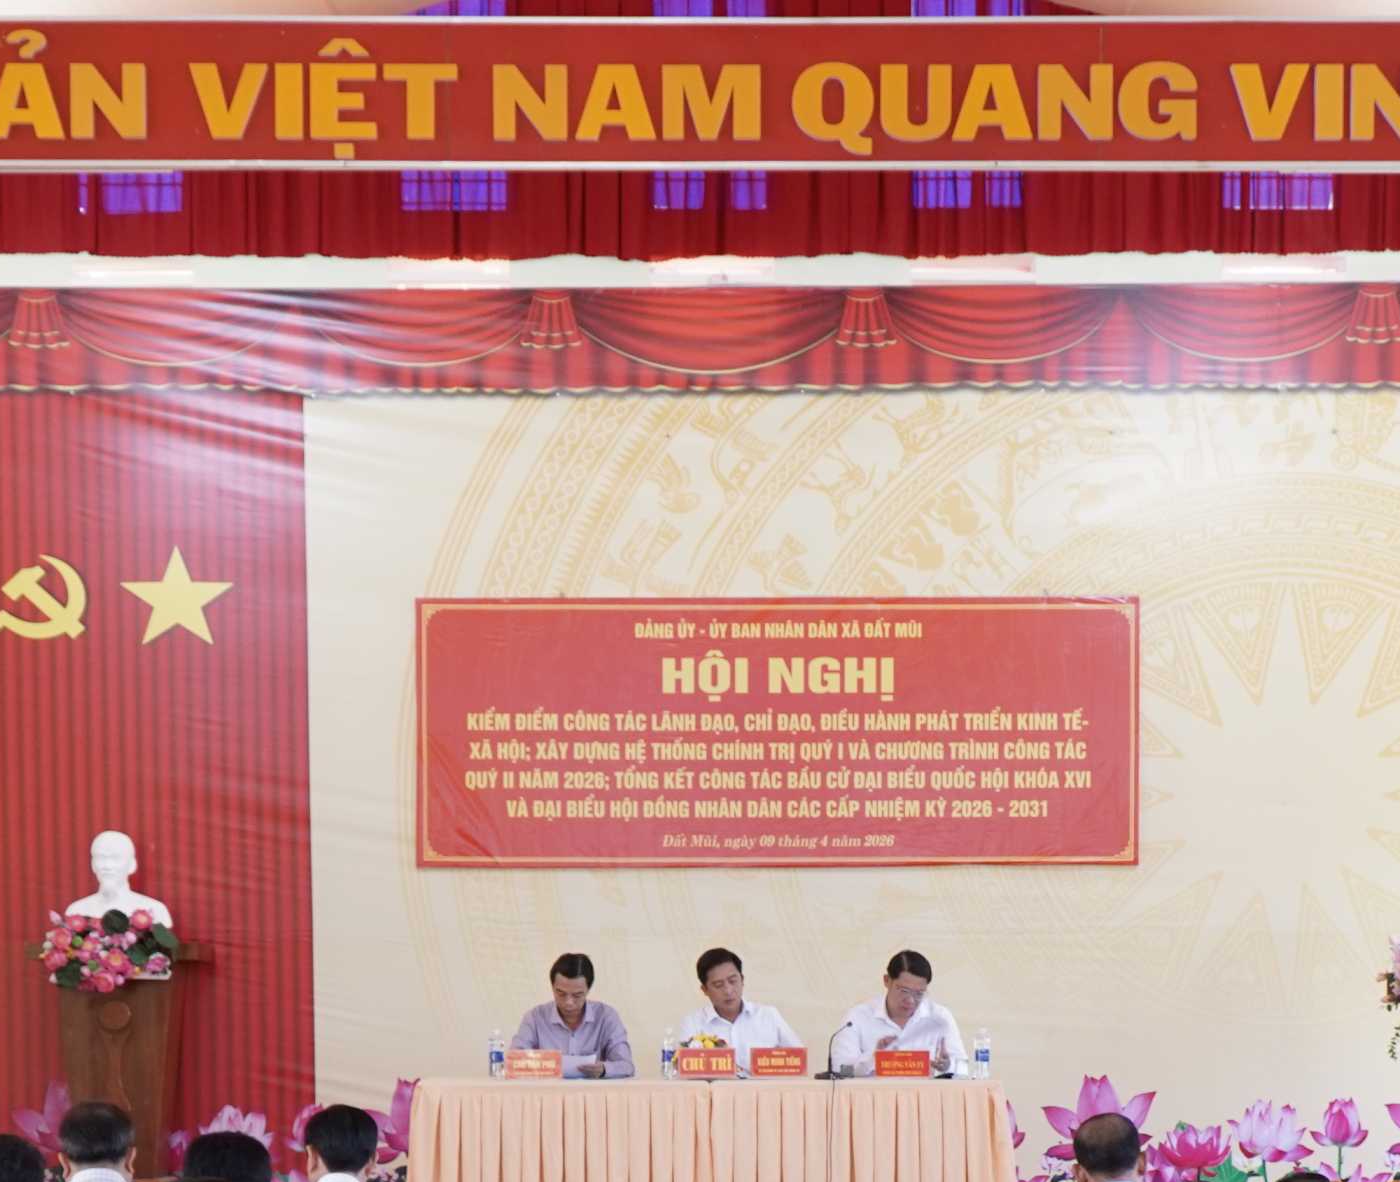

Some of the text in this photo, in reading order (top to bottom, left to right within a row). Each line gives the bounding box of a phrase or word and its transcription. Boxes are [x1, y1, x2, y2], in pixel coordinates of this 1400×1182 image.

[188, 37, 459, 159] VIỆT
[491, 62, 761, 142] NAM
[790, 61, 1200, 157] QUANG
[634, 618, 674, 639] ĐẢNG
[677, 618, 696, 639] ỦY
[709, 618, 728, 639] ỦY
[731, 622, 761, 639] BAN
[764, 619, 805, 638] NHÂN
[807, 619, 838, 639] DÂN
[841, 619, 861, 638] XÃ
[894, 619, 922, 638] MŨI
[662, 649, 895, 703] HỘI NGHỊ
[563, 709, 610, 732] CÔNG
[614, 710, 647, 732] TÁC
[651, 710, 696, 732] LÃNH
[700, 713, 739, 735] ĐẠO,
[743, 708, 773, 732] CHỈ
[776, 713, 816, 735] ĐẠO,
[864, 709, 911, 731] HÀNH
[915, 709, 959, 731] PHÁT
[1016, 712, 1058, 731] KINH
[469, 738, 493, 760] XÃ
[497, 738, 531, 764] HỘI;
[535, 738, 569, 760] XÂY
[573, 741, 620, 764] DỰNG
[624, 738, 647, 764] HỆ
[711, 739, 764, 761] CHÍNH
[768, 742, 795, 764] TRỊ
[799, 738, 833, 763] QUÝ
[837, 741, 844, 761] I
[848, 738, 871, 761] VÀ
[874, 740, 945, 761] CHƯƠNG
[948, 738, 999, 760] TRÌNH
[1003, 738, 1050, 760] CÔNG
[1054, 738, 1087, 760] TÁC
[464, 767, 498, 791] QUÝ
[502, 770, 515, 789] II
[519, 767, 559, 789] NĂM
[563, 771, 610, 791] 2026;
[699, 768, 746, 790] CÔNG
[750, 767, 783, 790] TÁC
[826, 765, 851, 789] CỬ
[853, 771, 883, 793] ĐẠI
[980, 767, 1009, 793] HỘI
[1014, 767, 1060, 789] KHÓA
[1063, 770, 1092, 789] XVI
[506, 796, 529, 818] VÀ
[532, 799, 562, 822] ĐẠI
[610, 797, 638, 822] HỘI
[694, 797, 743, 818] NHÂN
[747, 797, 783, 818] DÂN
[786, 796, 822, 819] CÁC
[864, 796, 920, 821] NHIỆM
[924, 796, 947, 818] KỲ
[951, 799, 993, 818] 2026
[1008, 799, 1048, 818] 2031
[681, 1052, 733, 1071] CHỦ TRÌ
